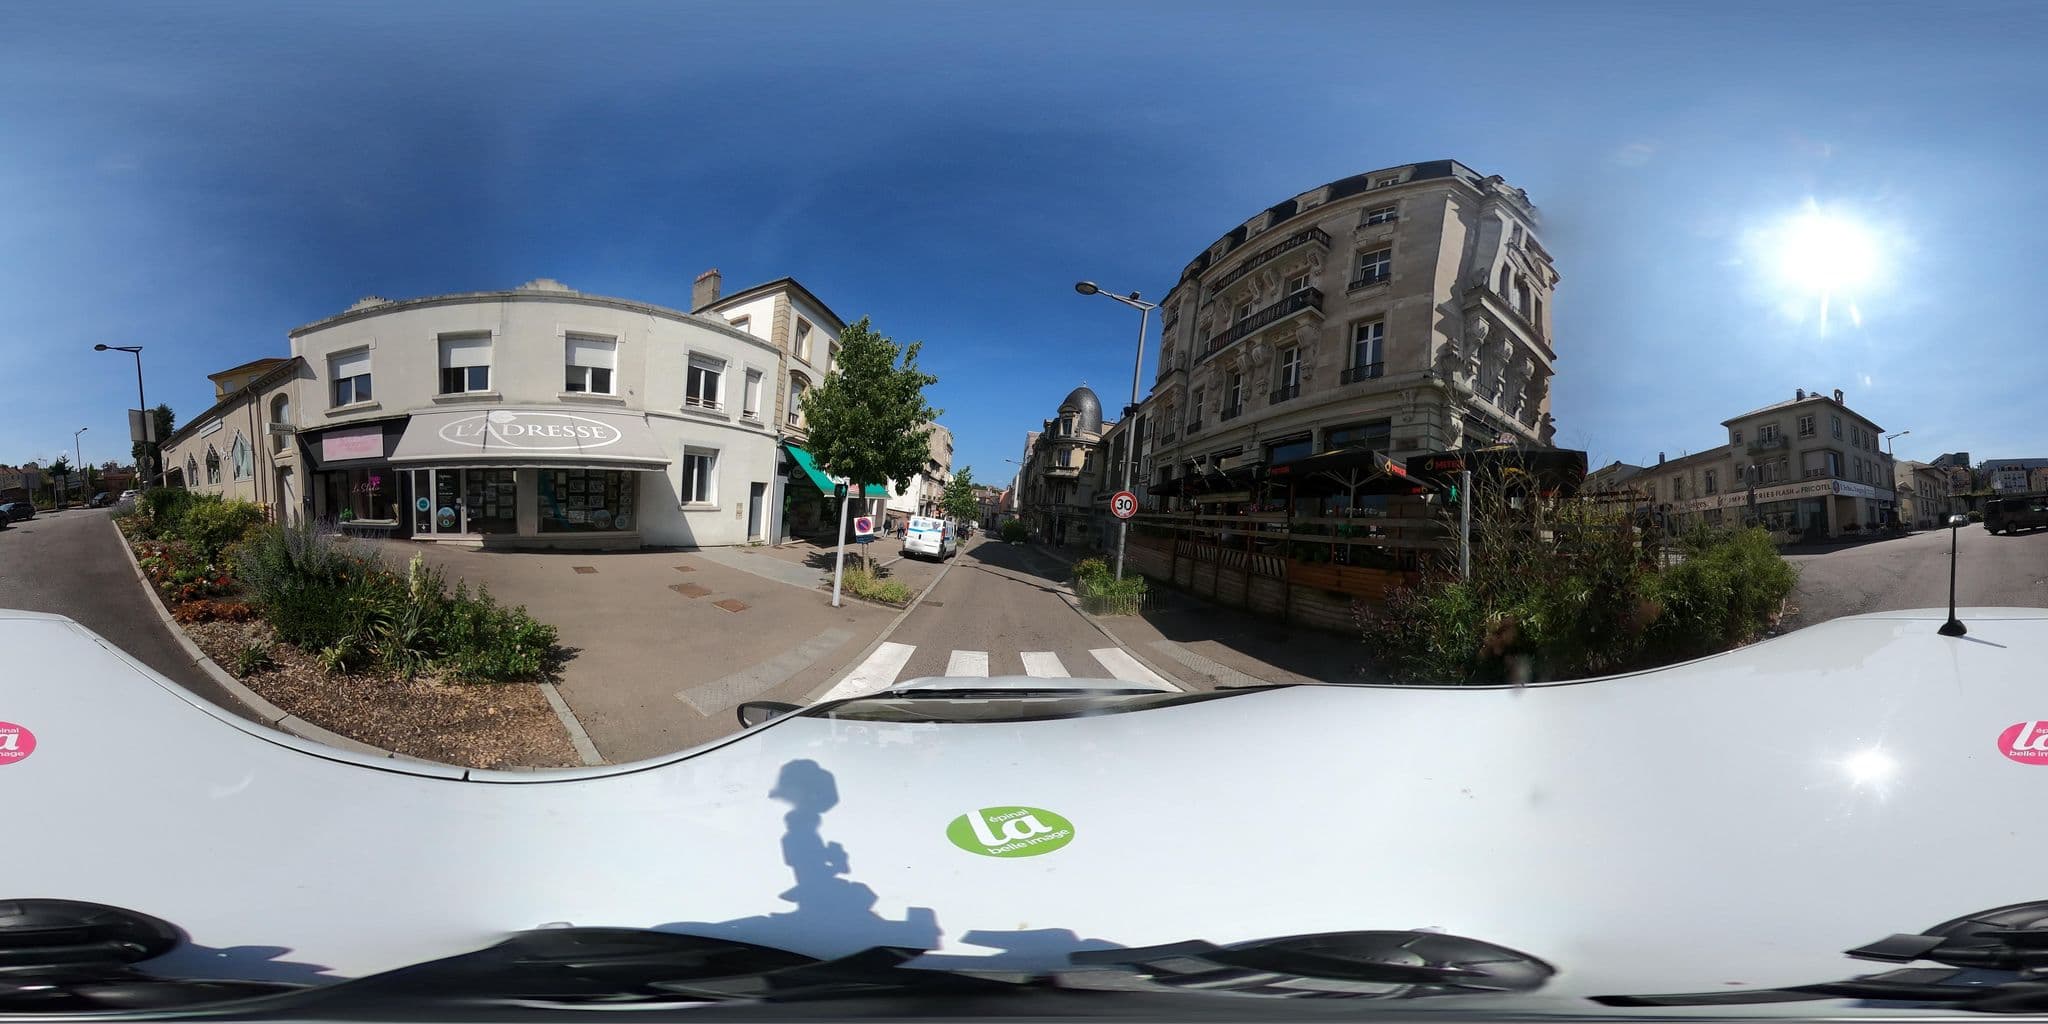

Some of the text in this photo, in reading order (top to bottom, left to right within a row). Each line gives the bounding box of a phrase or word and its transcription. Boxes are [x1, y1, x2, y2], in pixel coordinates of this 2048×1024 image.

[455, 421, 607, 441] L'ADRESSE
[1117, 499, 1132, 511] 30
[988, 809, 1029, 822] épinal
[966, 809, 1052, 846] la
[987, 828, 1071, 855] belle image
